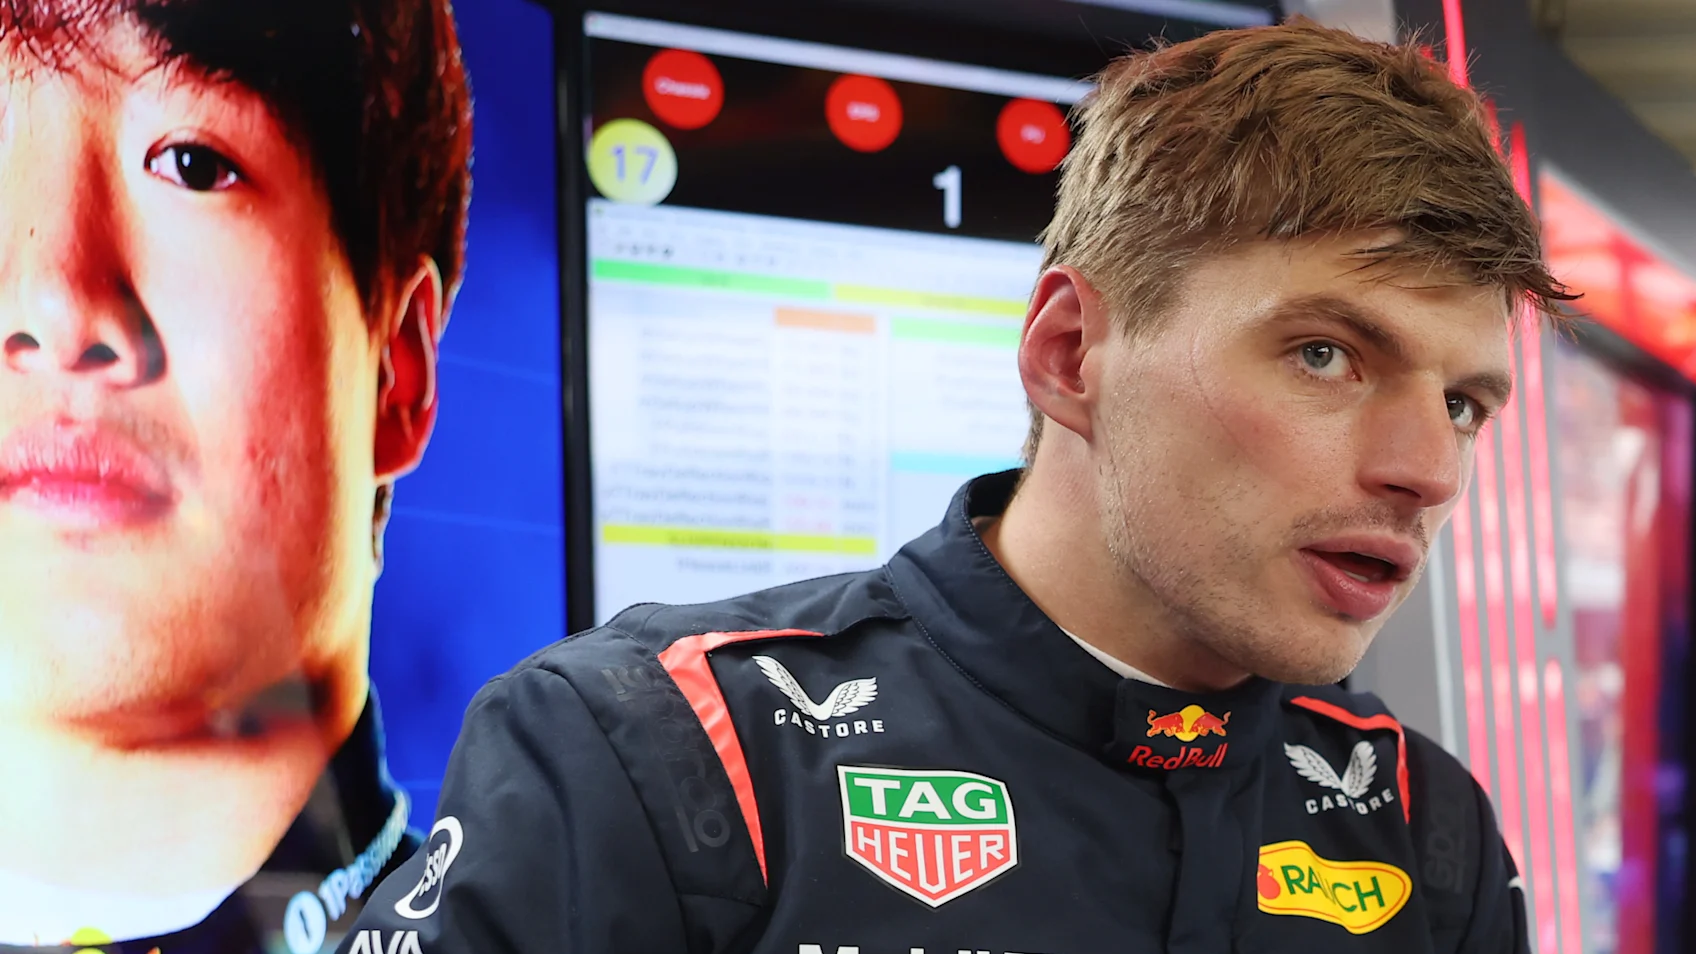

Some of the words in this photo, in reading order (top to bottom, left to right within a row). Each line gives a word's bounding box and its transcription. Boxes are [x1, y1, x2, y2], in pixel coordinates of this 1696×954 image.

[610, 145, 659, 186] 17
[932, 165, 962, 229] 1
[774, 708, 885, 739] CASTORE
[1127, 745, 1187, 771] Red
[1183, 743, 1228, 769] Bull
[853, 777, 997, 820] TAG
[856, 825, 1005, 895] HEUER
